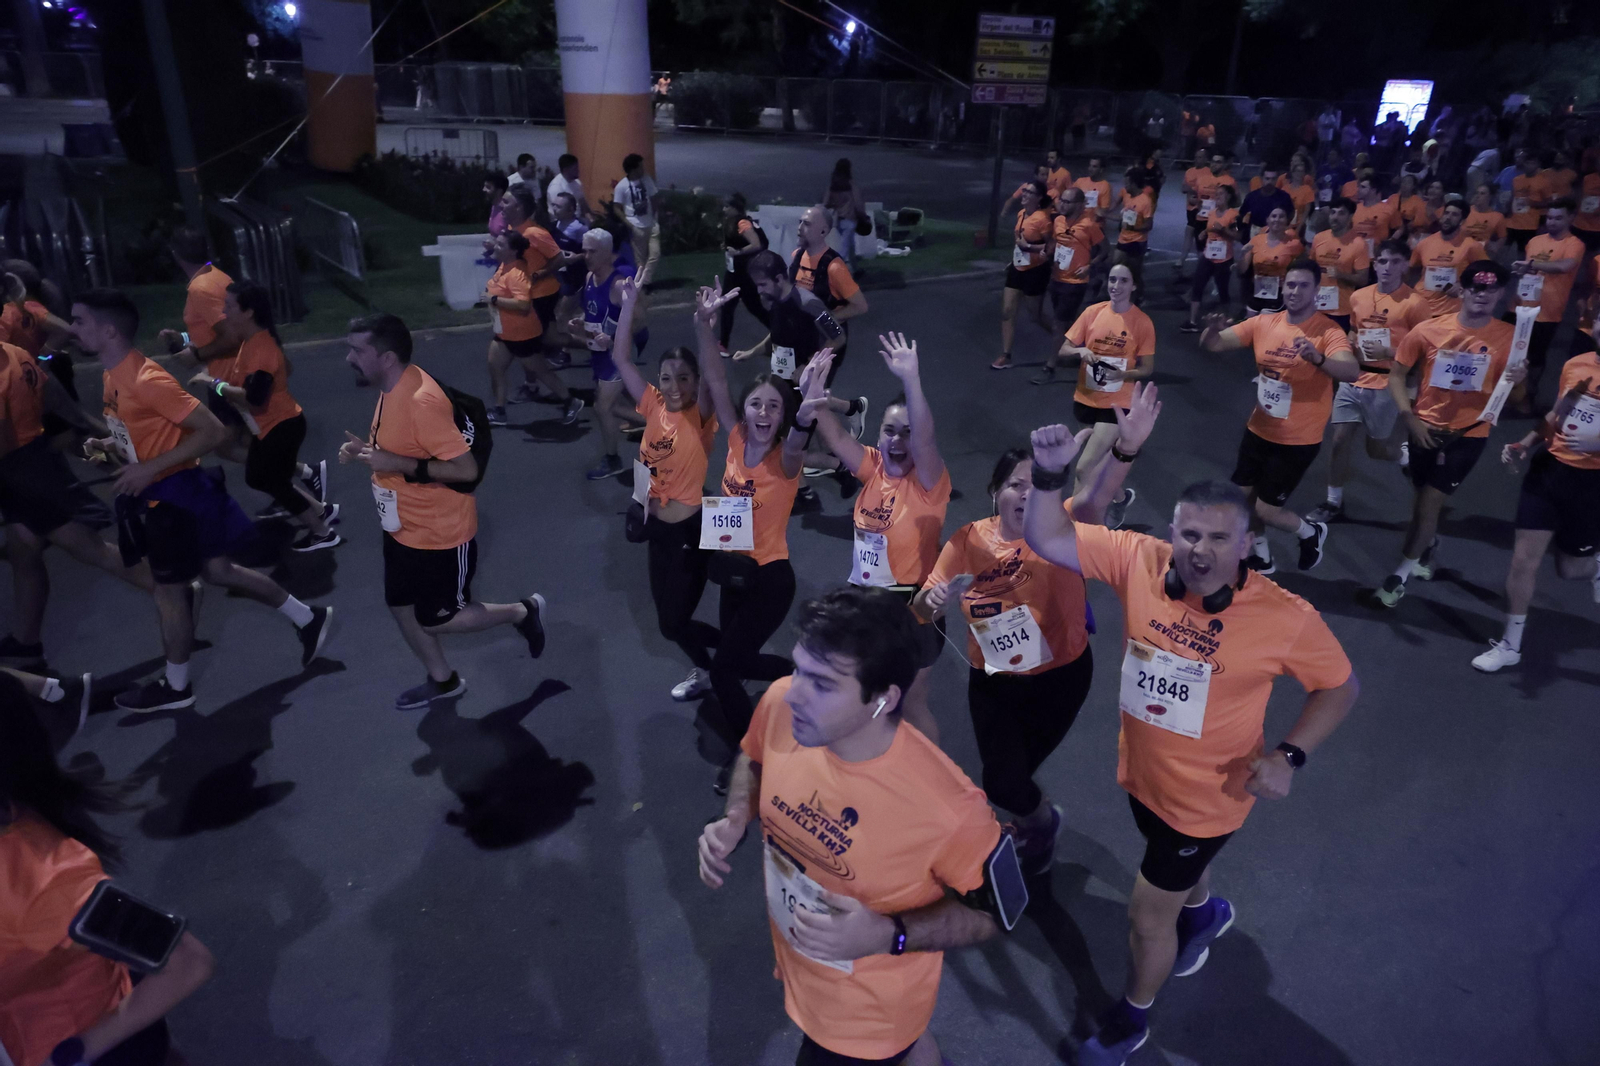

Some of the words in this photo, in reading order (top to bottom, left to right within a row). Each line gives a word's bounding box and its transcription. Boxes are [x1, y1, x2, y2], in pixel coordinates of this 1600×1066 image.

[1445, 363, 1478, 376] 20502
[712, 514, 742, 528] 15168
[860, 549, 879, 567] 14702
[990, 627, 1030, 653] 15314
[1148, 619, 1187, 646] SEVILLA
[1171, 621, 1221, 649] NOCTURNA
[1137, 670, 1189, 702] 21848
[770, 795, 818, 837] SEVILLA
[797, 801, 854, 848] NOCTURNA
